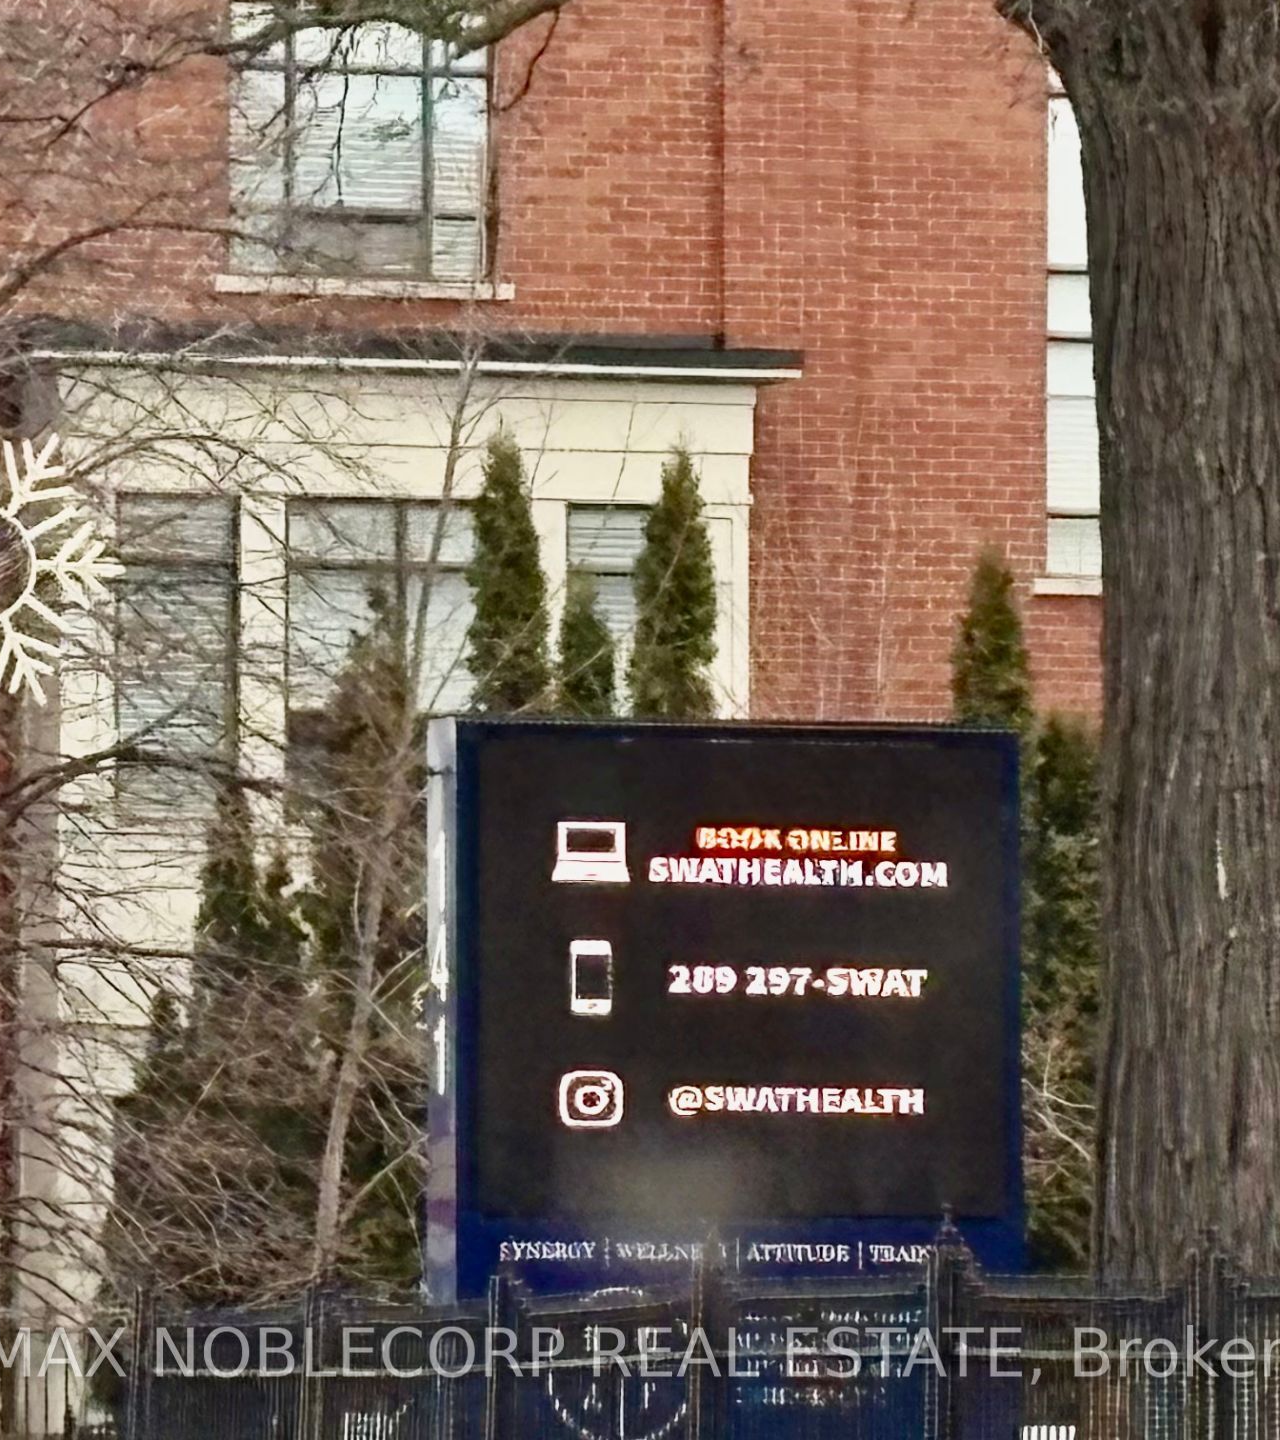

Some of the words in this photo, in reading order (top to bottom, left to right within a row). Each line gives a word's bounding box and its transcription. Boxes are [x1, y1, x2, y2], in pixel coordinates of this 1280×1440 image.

[696, 827, 783, 851] BOOK
[786, 828, 898, 853] ONLINE
[647, 857, 949, 888] SWATHEALTH.COM
[744, 965, 929, 998] 297-SWAT
[668, 1085, 925, 1116] @SWATHEALTH
[499, 1240, 596, 1262] SYNERGY
[746, 1241, 851, 1262] ATTITUDE
